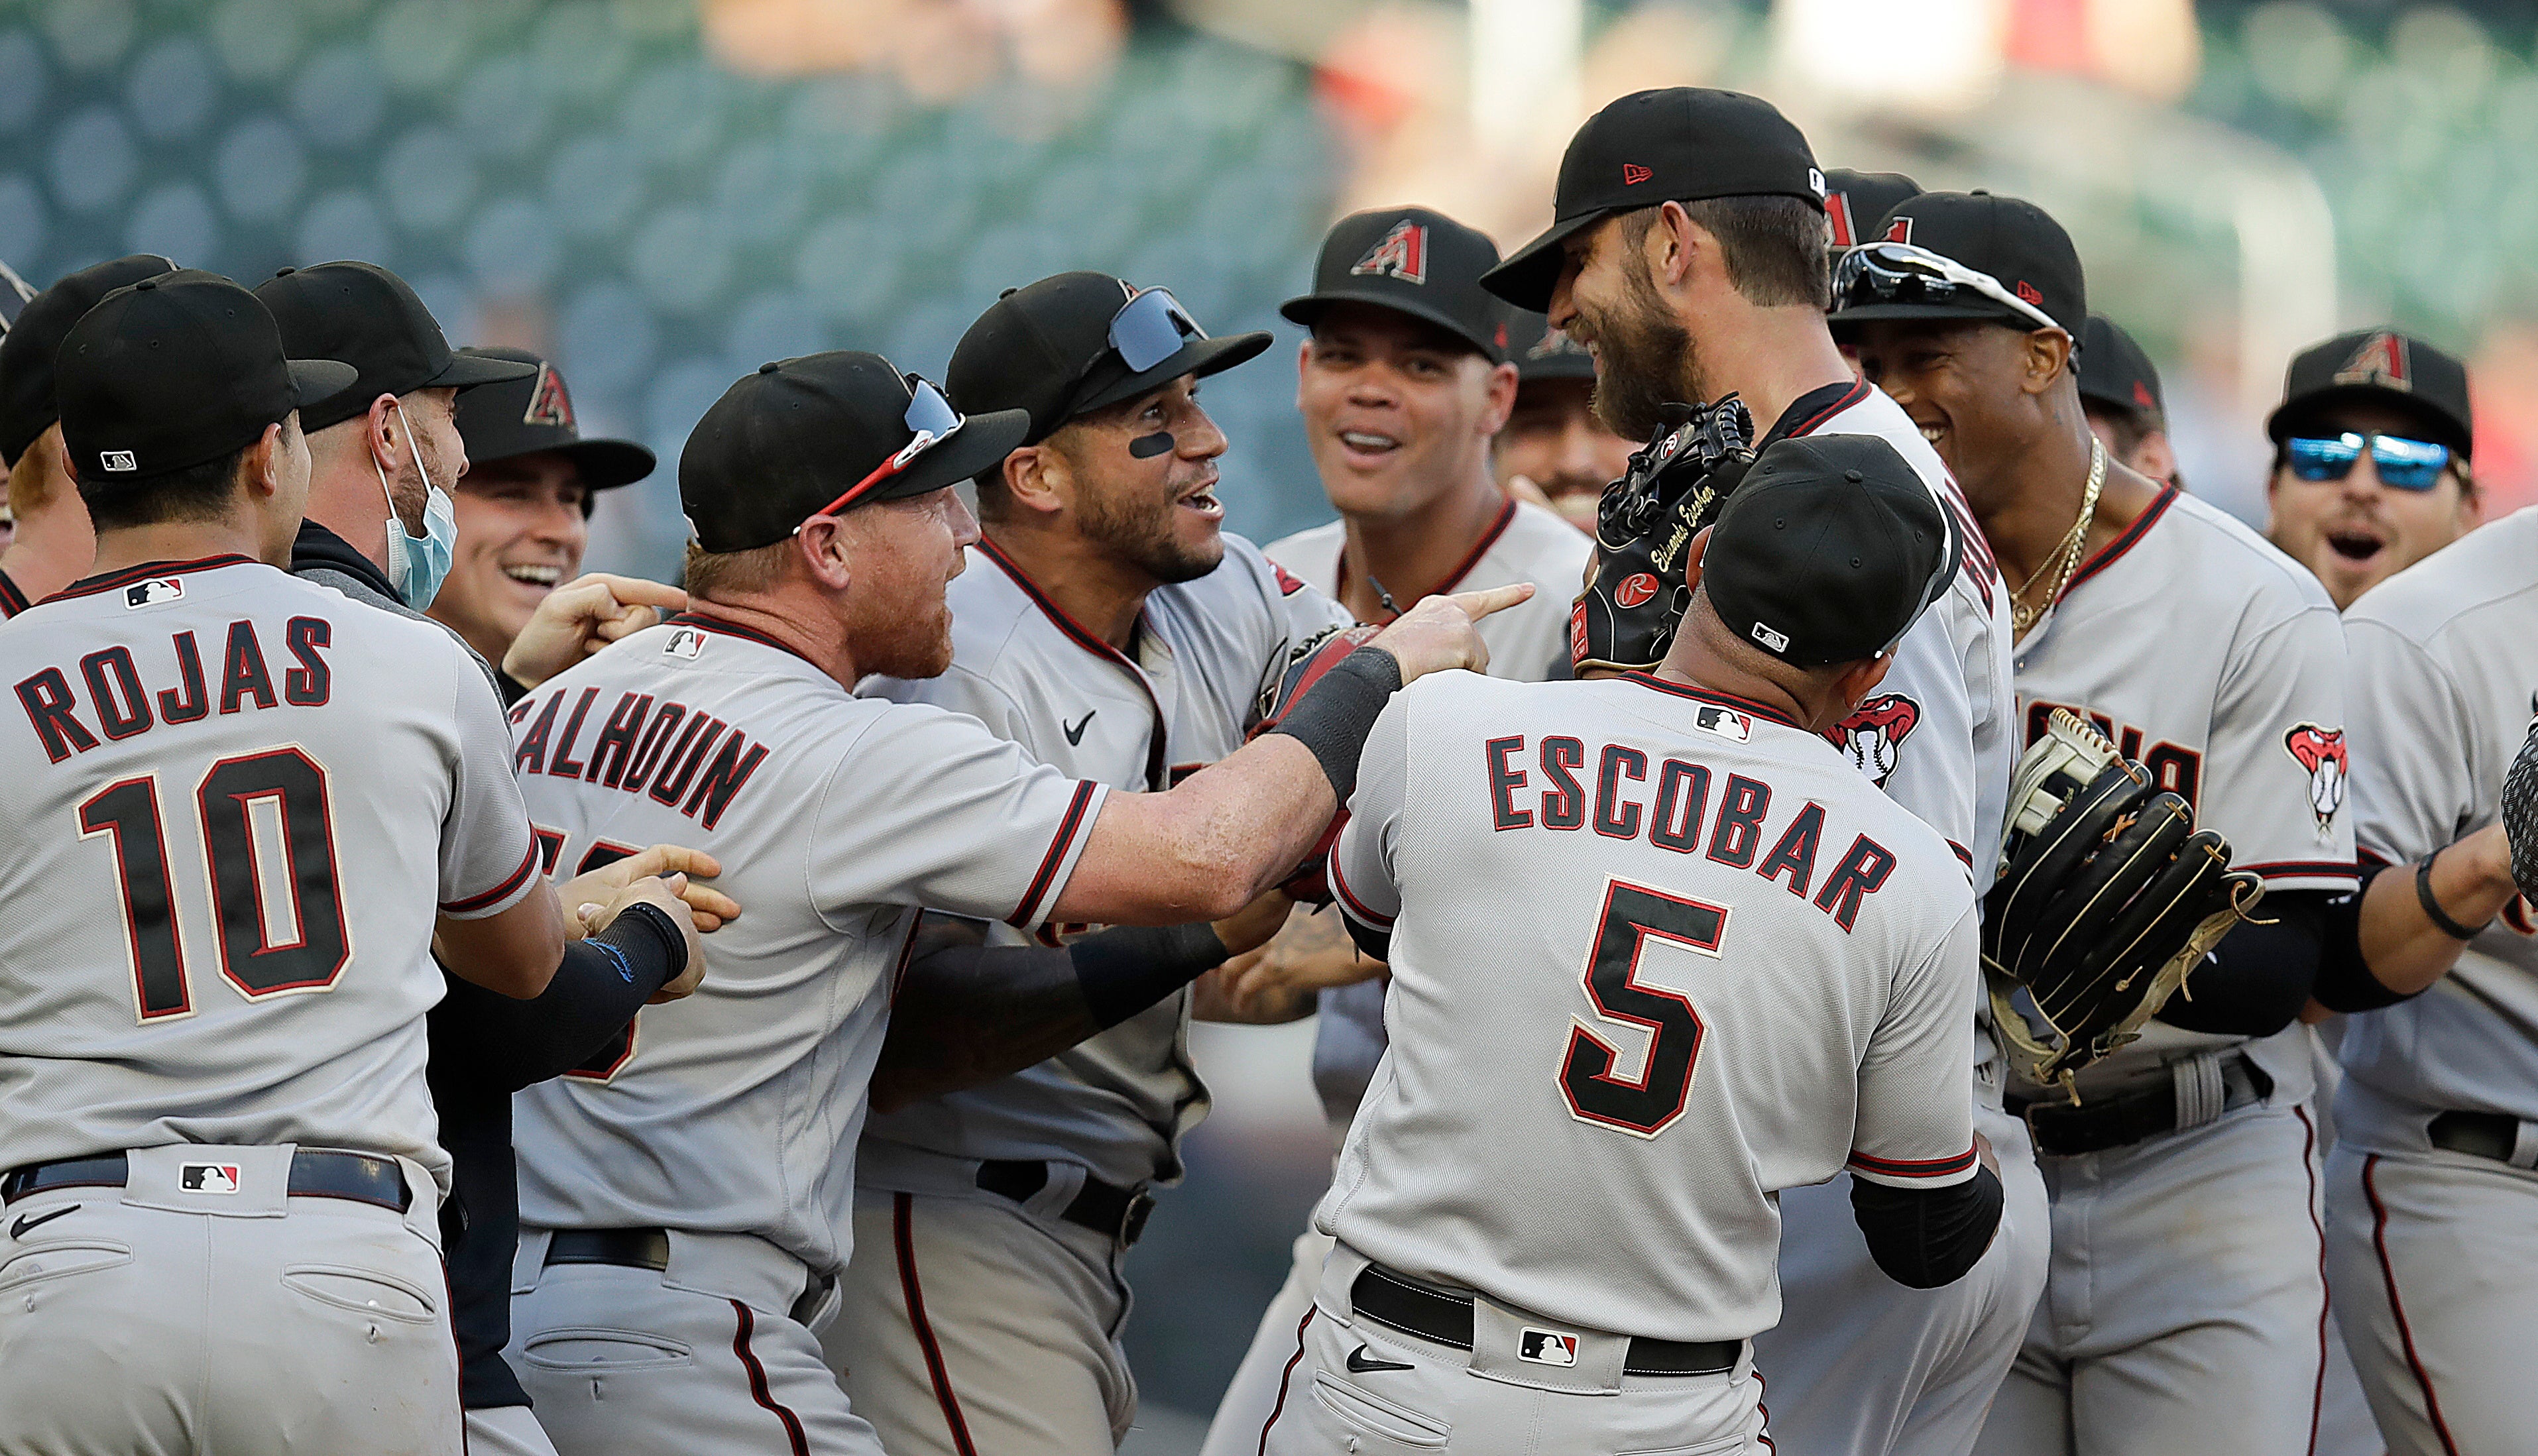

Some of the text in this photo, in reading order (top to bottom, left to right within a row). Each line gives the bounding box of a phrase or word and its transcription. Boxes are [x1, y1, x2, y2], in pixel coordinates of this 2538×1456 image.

[14, 616, 331, 764] ROJAS
[73, 742, 355, 1026] 10
[1485, 734, 1898, 934] ESCOBAR
[1554, 872, 1735, 1141] 5
